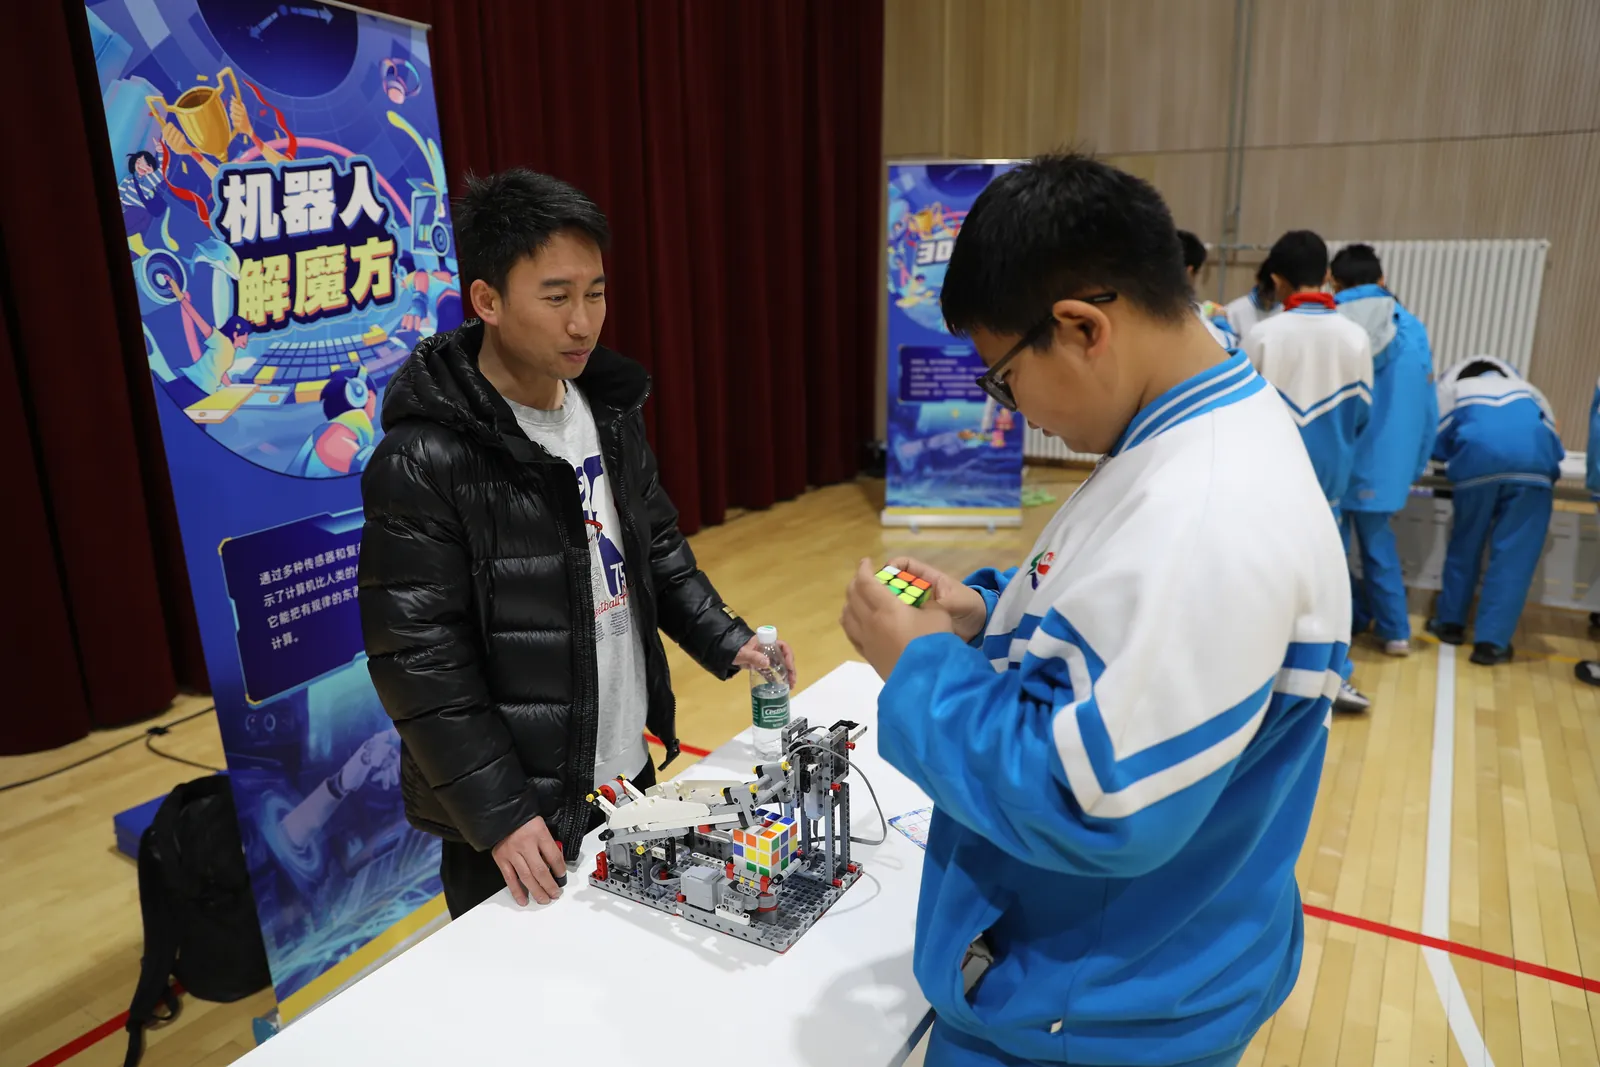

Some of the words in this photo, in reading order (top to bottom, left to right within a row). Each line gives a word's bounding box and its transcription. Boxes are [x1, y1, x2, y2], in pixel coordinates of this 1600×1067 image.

[221, 166, 384, 244] 机器人
[238, 237, 395, 325] 解魔方
[263, 564, 359, 607] 示了计算机比人类的
